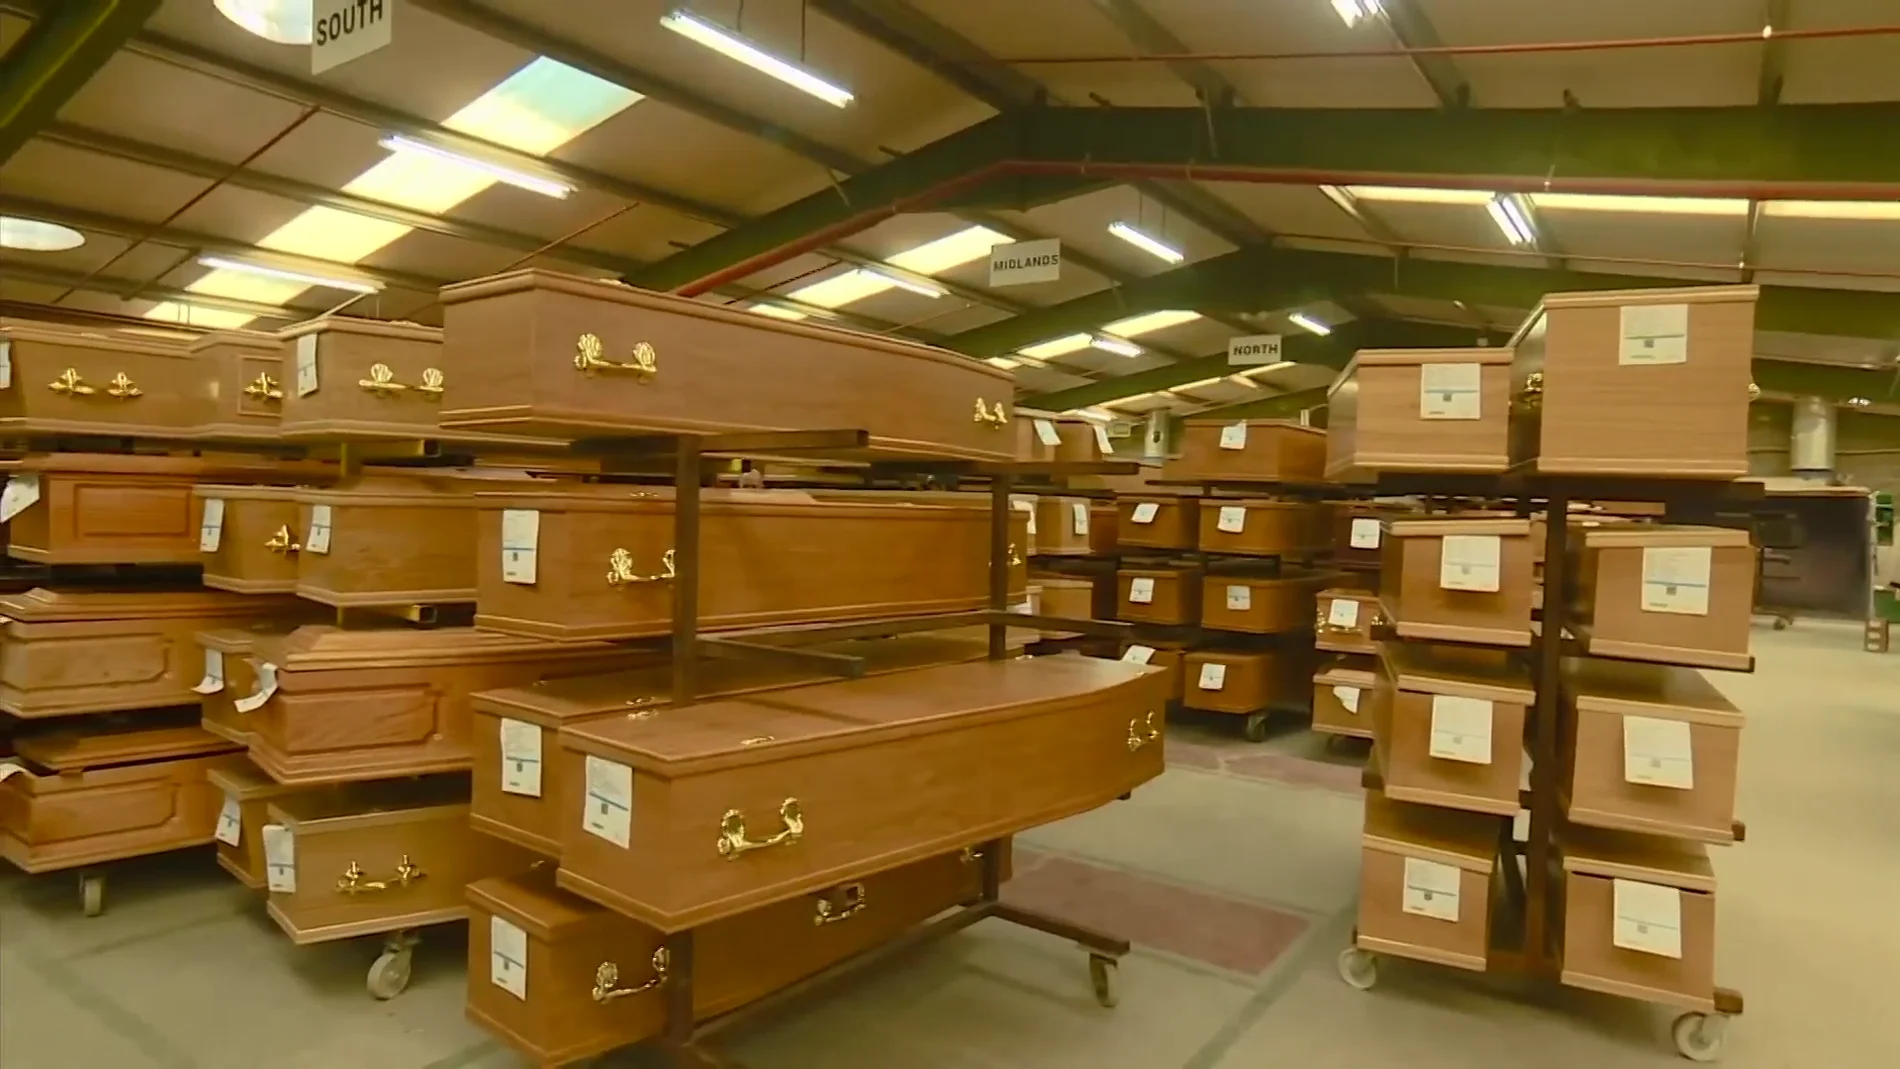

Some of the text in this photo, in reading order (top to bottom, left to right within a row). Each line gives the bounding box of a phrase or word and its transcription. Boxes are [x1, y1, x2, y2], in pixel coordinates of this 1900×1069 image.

[317, 0, 382, 46] SOUTH
[993, 254, 1059, 271] MIDLANDS
[1233, 343, 1278, 355] NORTH
